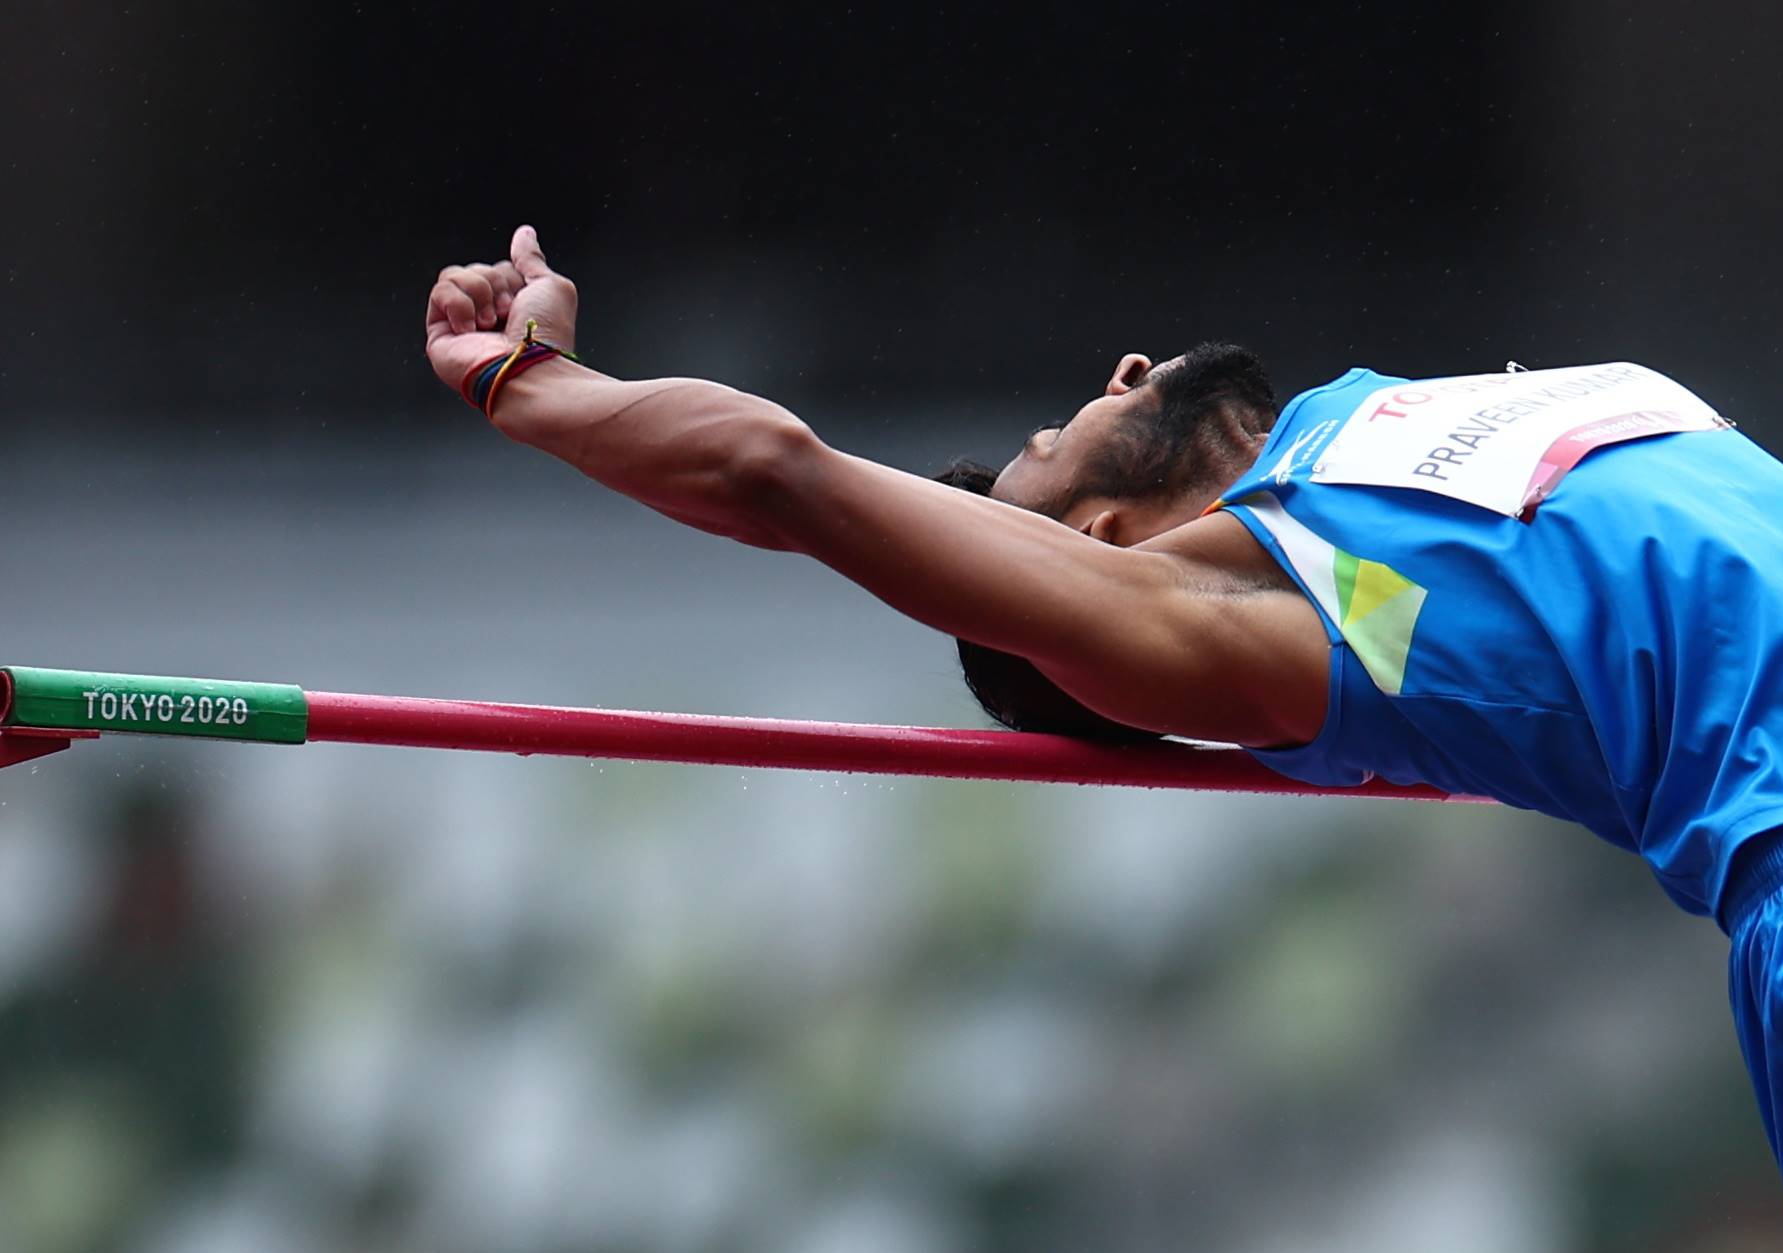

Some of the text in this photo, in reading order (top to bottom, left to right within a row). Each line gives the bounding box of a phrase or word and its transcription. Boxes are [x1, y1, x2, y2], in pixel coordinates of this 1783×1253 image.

[1412, 396, 1551, 481] PRAVEEN
[1540, 366, 1648, 402] KUMAR
[83, 691, 248, 725] TOKYO 2020
